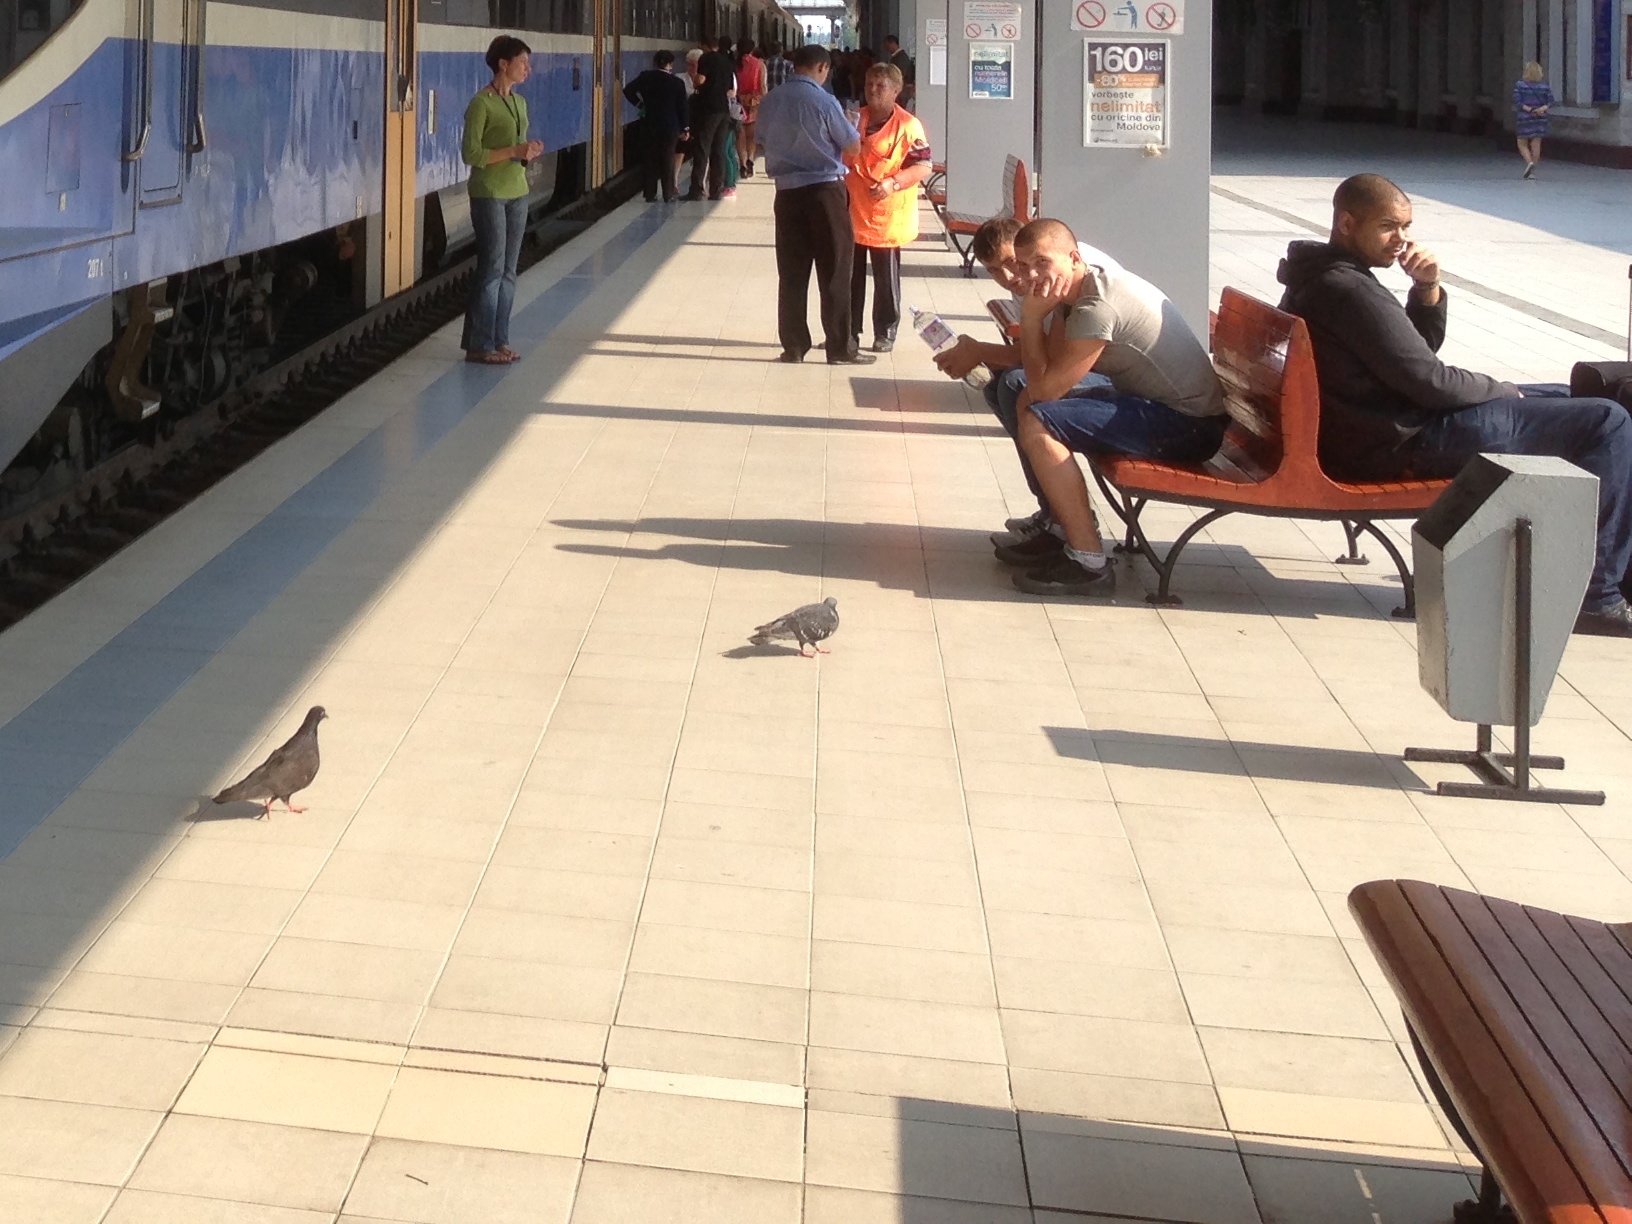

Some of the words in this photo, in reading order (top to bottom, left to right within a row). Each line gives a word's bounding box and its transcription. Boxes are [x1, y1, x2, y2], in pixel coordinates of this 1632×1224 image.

[1090, 46, 1143, 72] 160
[1144, 47, 1163, 61] lei
[1091, 100, 1161, 113] nelimitat
[1106, 113, 1142, 122] oricine
[1145, 113, 1161, 122] din
[1116, 122, 1160, 131] Moldova
